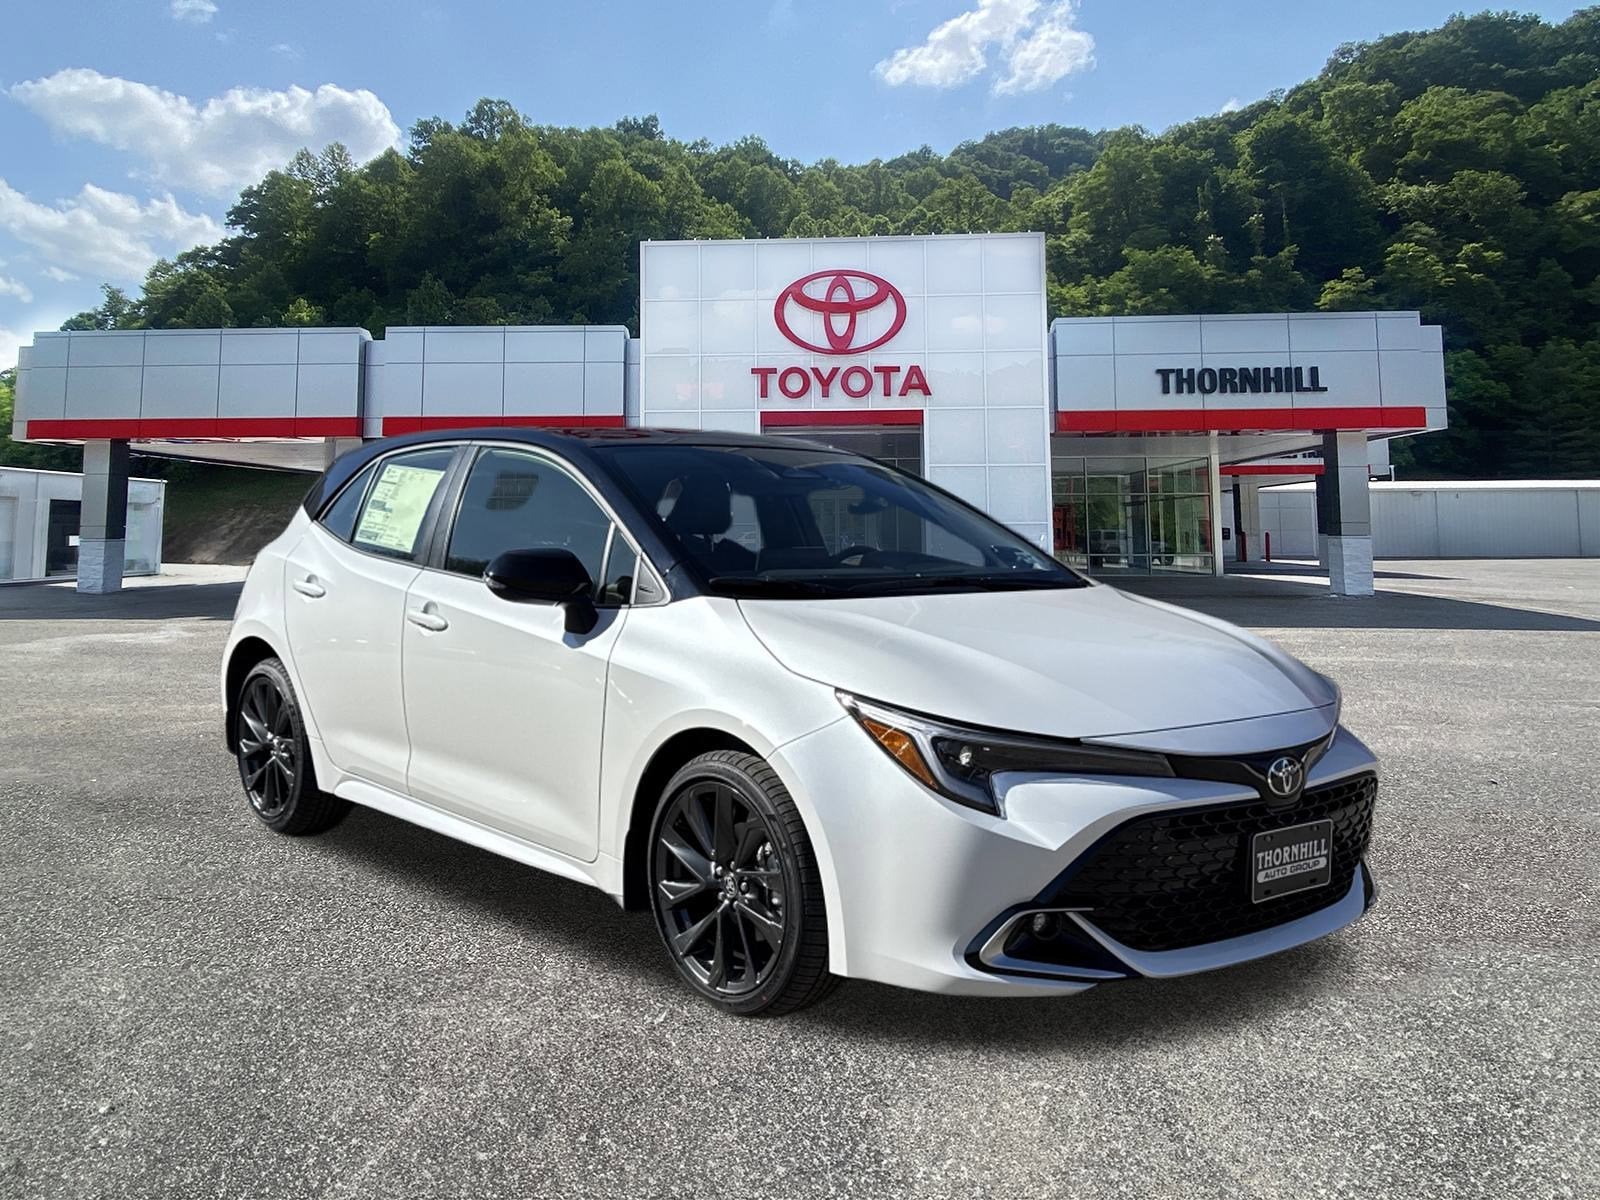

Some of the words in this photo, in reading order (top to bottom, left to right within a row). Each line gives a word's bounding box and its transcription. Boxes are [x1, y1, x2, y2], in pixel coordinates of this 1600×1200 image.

[751, 365, 932, 399] TOYOTA
[1156, 366, 1328, 394] THORNHILL
[1257, 838, 1328, 870] THORNHILL
[1264, 867, 1287, 880] AUTO
[1290, 860, 1320, 873] GROUP
